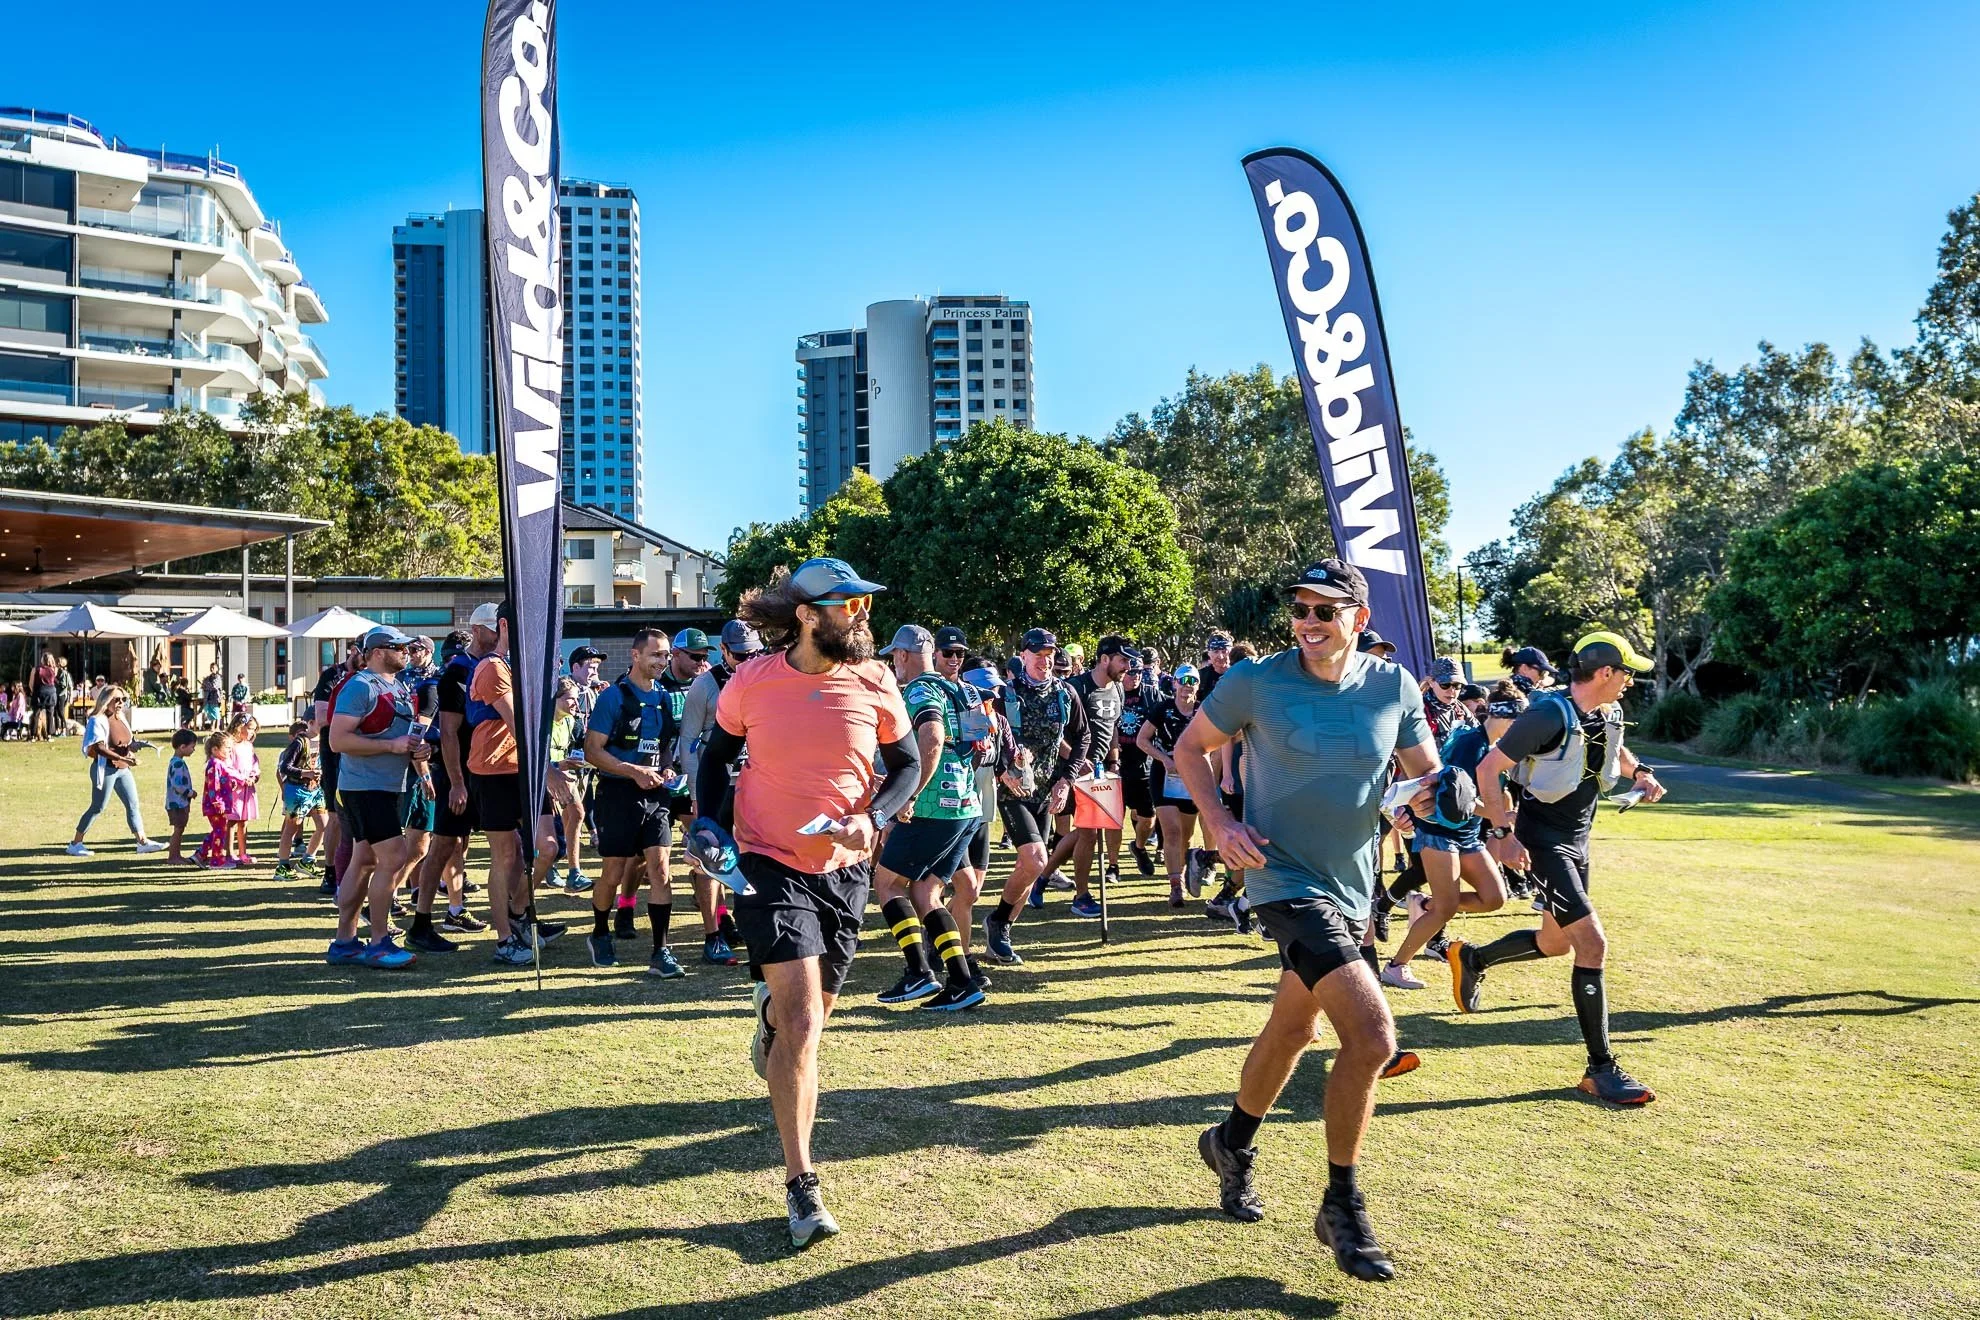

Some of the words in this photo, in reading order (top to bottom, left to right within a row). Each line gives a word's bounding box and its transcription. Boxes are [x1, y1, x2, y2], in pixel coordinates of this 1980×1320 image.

[499, 0, 563, 518] Wild&Co.
[943, 309, 991, 318] Princess
[995, 308, 1023, 318] Palm
